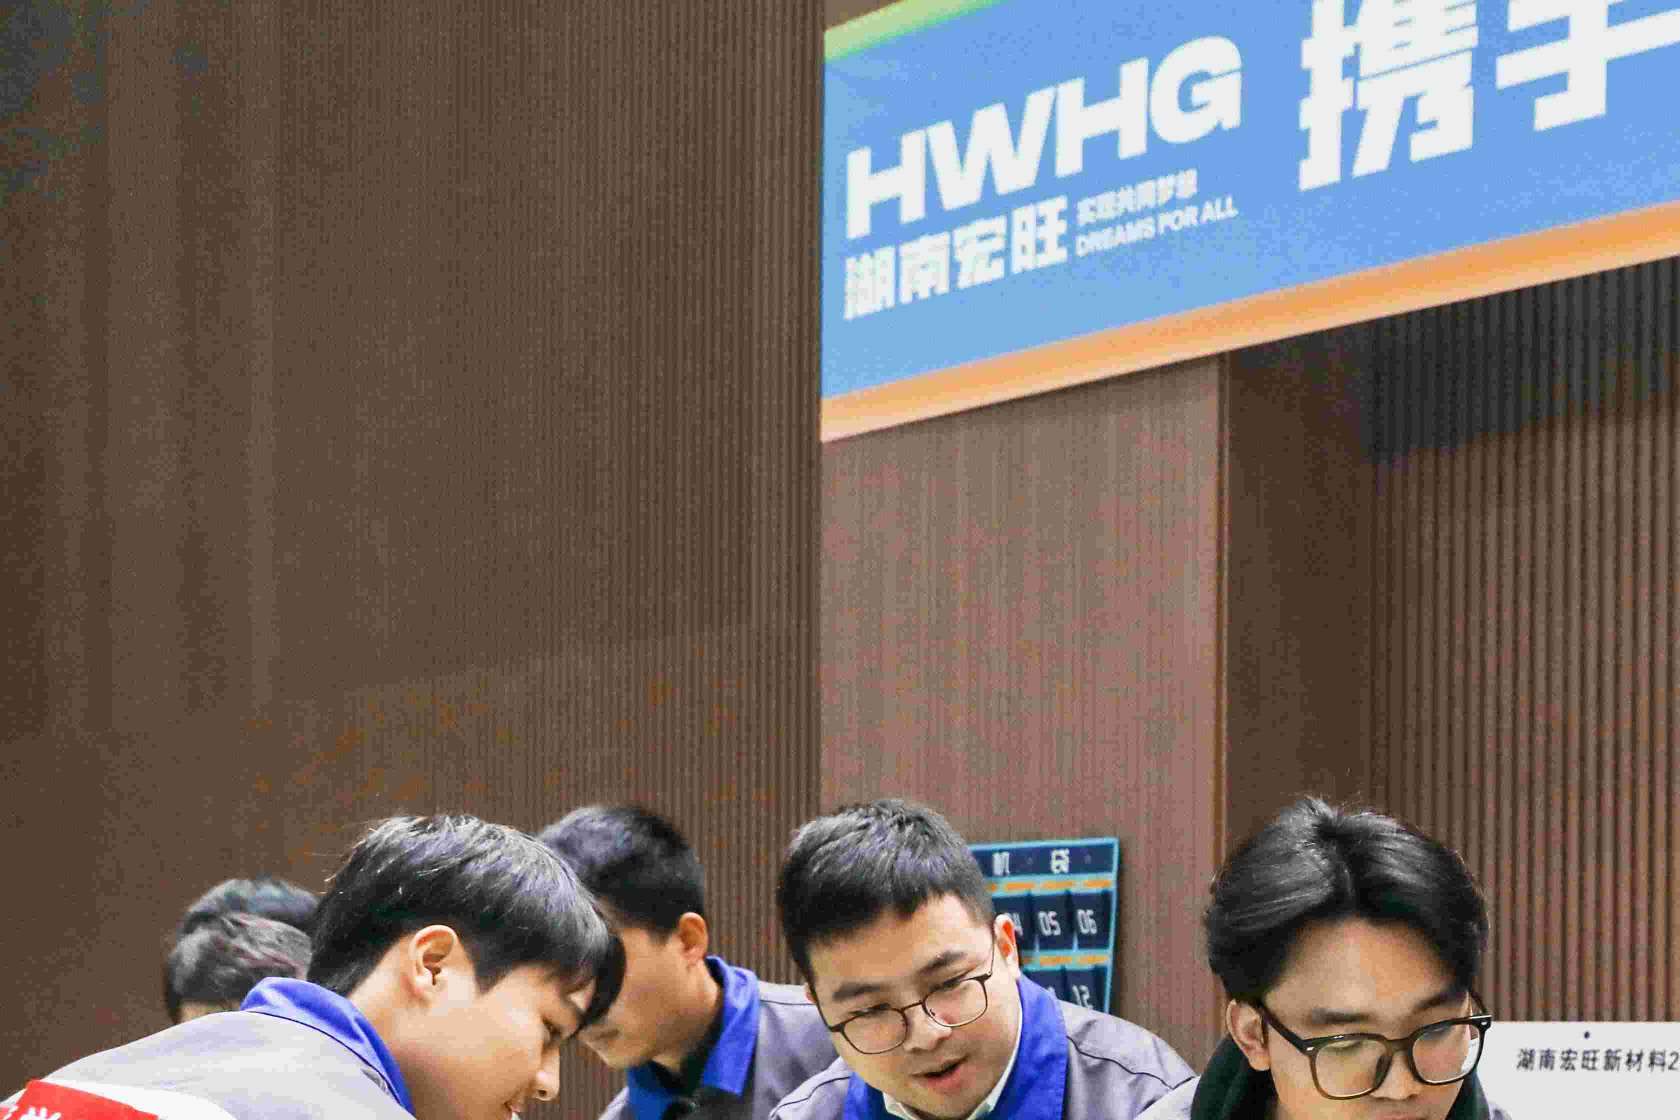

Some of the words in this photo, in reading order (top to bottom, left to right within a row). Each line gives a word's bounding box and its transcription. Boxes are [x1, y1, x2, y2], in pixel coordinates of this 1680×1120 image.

[846, 36, 1242, 239] HWHG
[844, 195, 1068, 320] 湖南宏旺
[1075, 217, 1156, 257] DREAMS
[1157, 205, 1199, 235] FOR
[1199, 195, 1239, 224] ALL
[1038, 911, 1061, 936] 05
